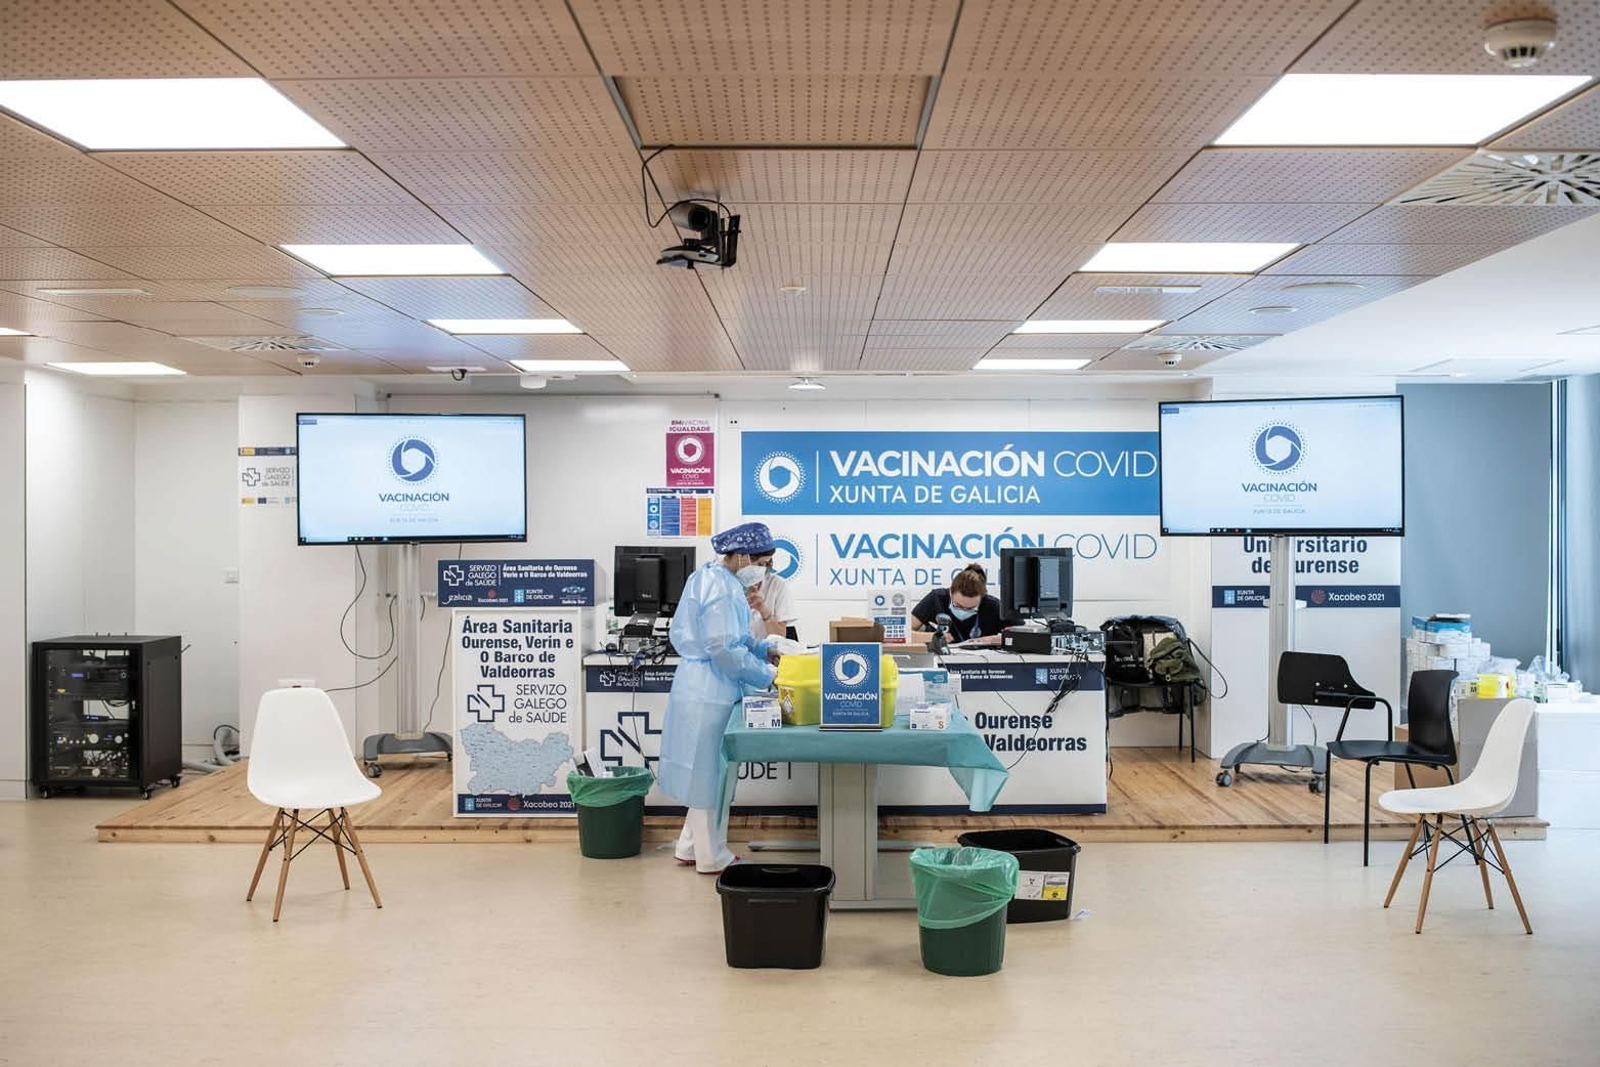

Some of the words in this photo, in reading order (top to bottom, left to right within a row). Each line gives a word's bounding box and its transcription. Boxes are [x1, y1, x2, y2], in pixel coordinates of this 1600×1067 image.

[830, 444, 1045, 477] VACINACIÓN
[1053, 450, 1158, 477] COVID
[1241, 480, 1317, 492] VACINACIÓN
[378, 491, 450, 502] VACINACIÓN
[830, 486, 906, 503] XUNTA
[914, 486, 942, 503] DE
[951, 485, 1040, 504] GALICIA
[1295, 560, 1359, 573] urense
[468, 571, 497, 579] GALEGO
[830, 568, 906, 586] XUNTA
[914, 568, 942, 586] DE
[1328, 592, 1366, 601] Xacobeo
[1367, 593, 1385, 601] 2021
[462, 615, 497, 634] Área
[502, 618, 573, 634] Sanitaria
[462, 635, 522, 651] Ourense,
[565, 637, 574, 649] e
[480, 651, 489, 663] O
[494, 651, 534, 663] Barco
[538, 651, 556, 663] de
[480, 665, 556, 679] Valdeorras
[516, 683, 567, 695] SERVIZO
[824, 691, 878, 701] VACINACIÓN
[514, 697, 567, 709] GALEGO
[508, 711, 523, 723] de
[526, 709, 567, 723] SAÚDE
[974, 711, 1053, 730] Ourense
[771, 719, 780, 727] M
[938, 720, 944, 729] S
[983, 733, 1087, 752] Valdeorras
[523, 800, 558, 809] Xacobeo
[559, 801, 575, 809] 2021
